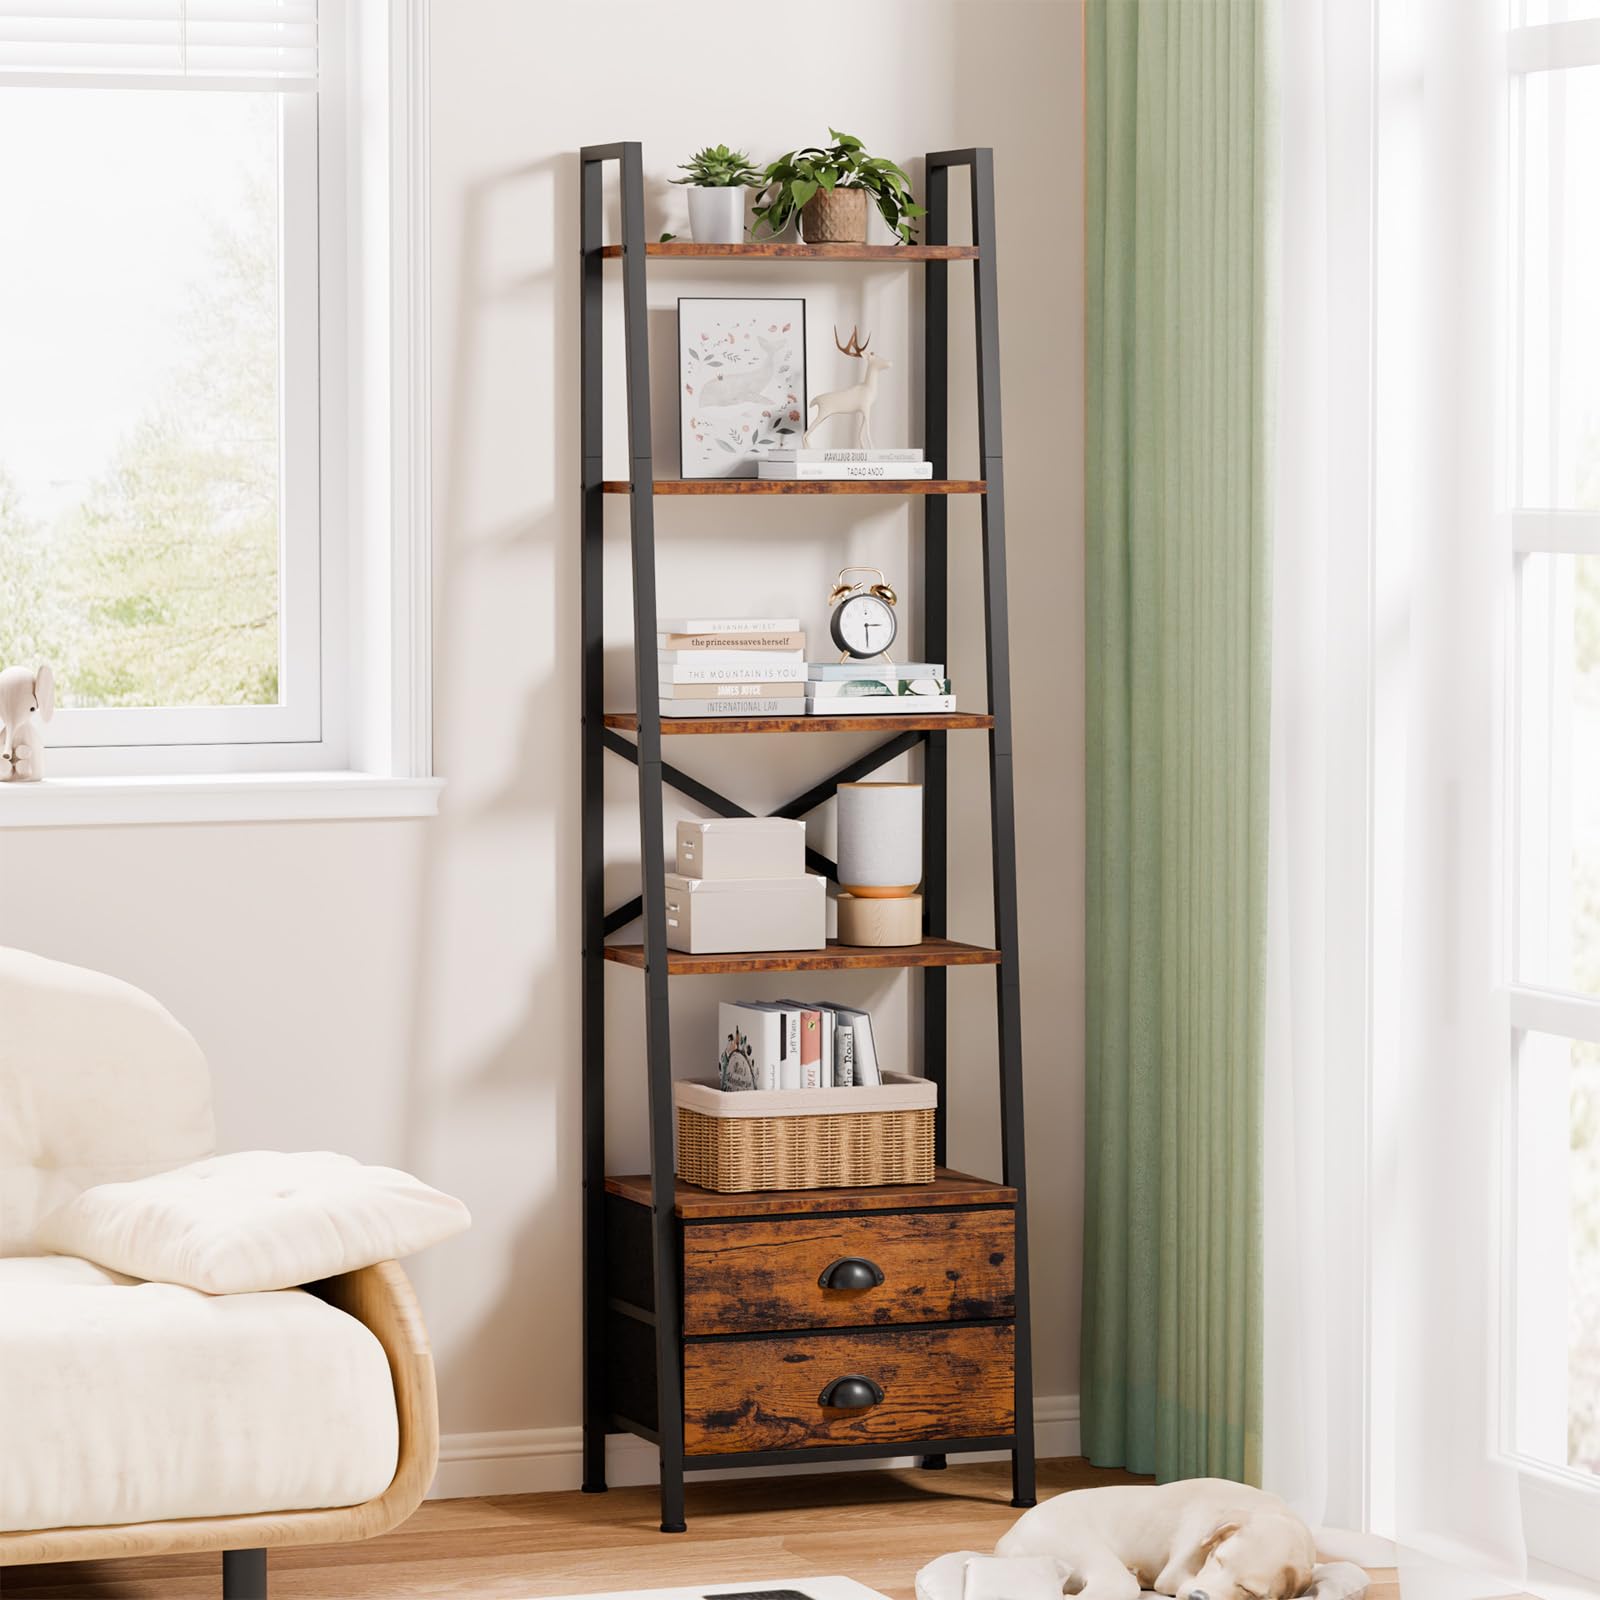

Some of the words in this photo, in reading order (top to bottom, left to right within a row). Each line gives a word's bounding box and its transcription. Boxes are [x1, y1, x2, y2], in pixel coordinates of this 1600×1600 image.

[691, 638, 705, 646] the
[705, 638, 739, 648] princess
[762, 637, 790, 646] herself
[688, 671, 705, 679] THE
[710, 670, 761, 679] MOUNTAIN
[764, 670, 774, 678] IS
[777, 669, 797, 678] YOU
[717, 685, 739, 696] JAMES
[740, 685, 761, 696] JOYCE
[707, 702, 761, 713] INTERNATIONAL
[763, 701, 778, 712] LAW
[843, 1032, 852, 1064] Road
